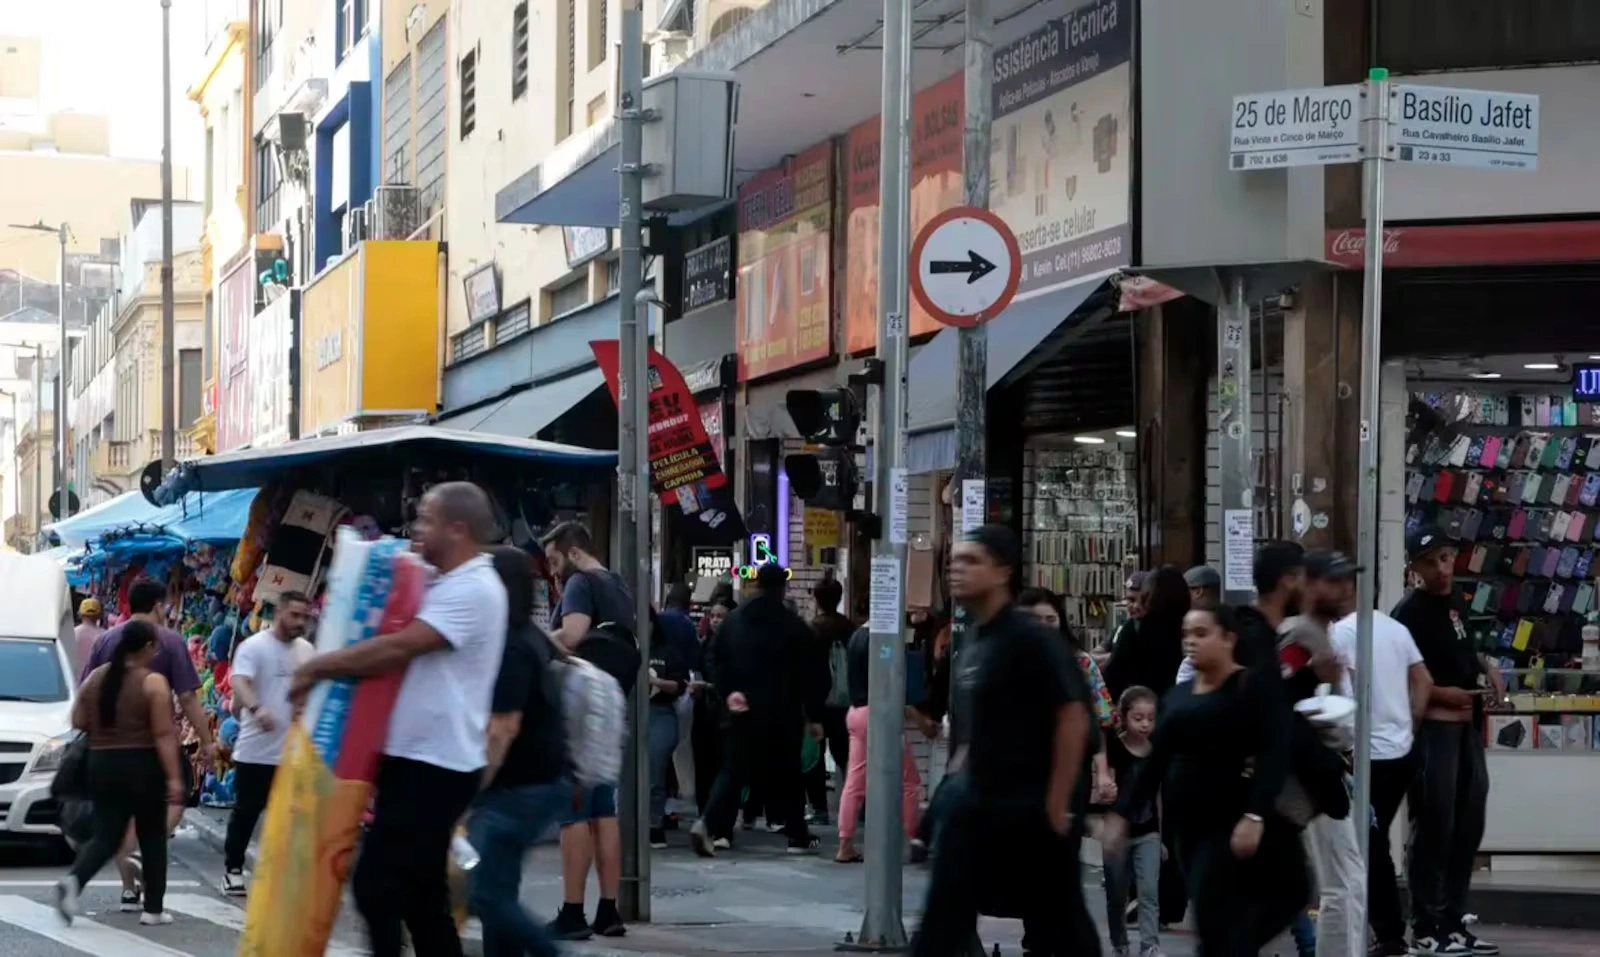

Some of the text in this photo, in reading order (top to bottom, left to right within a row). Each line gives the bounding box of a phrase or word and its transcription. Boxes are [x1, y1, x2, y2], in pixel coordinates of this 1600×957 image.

[992, 1, 1117, 84] ssistência Técnica
[1235, 95, 1352, 128] 25 de Março
[1403, 92, 1533, 129] Basílio Jafet
[1234, 129, 1344, 146] Rua Vinte e Cinco de Março
[1402, 128, 1420, 138] Rua
[1422, 129, 1470, 142] Cavalheiro
[1503, 136, 1525, 147] Jafet
[1265, 156, 1271, 164] a
[1418, 151, 1451, 162] 23 a 33
[1063, 205, 1096, 239] celular
[1033, 258, 1053, 277] Kevin
[652, 447, 699, 470] PELÍCULA
[664, 469, 704, 489] CAPINHA
[698, 556, 731, 568] PRATA
